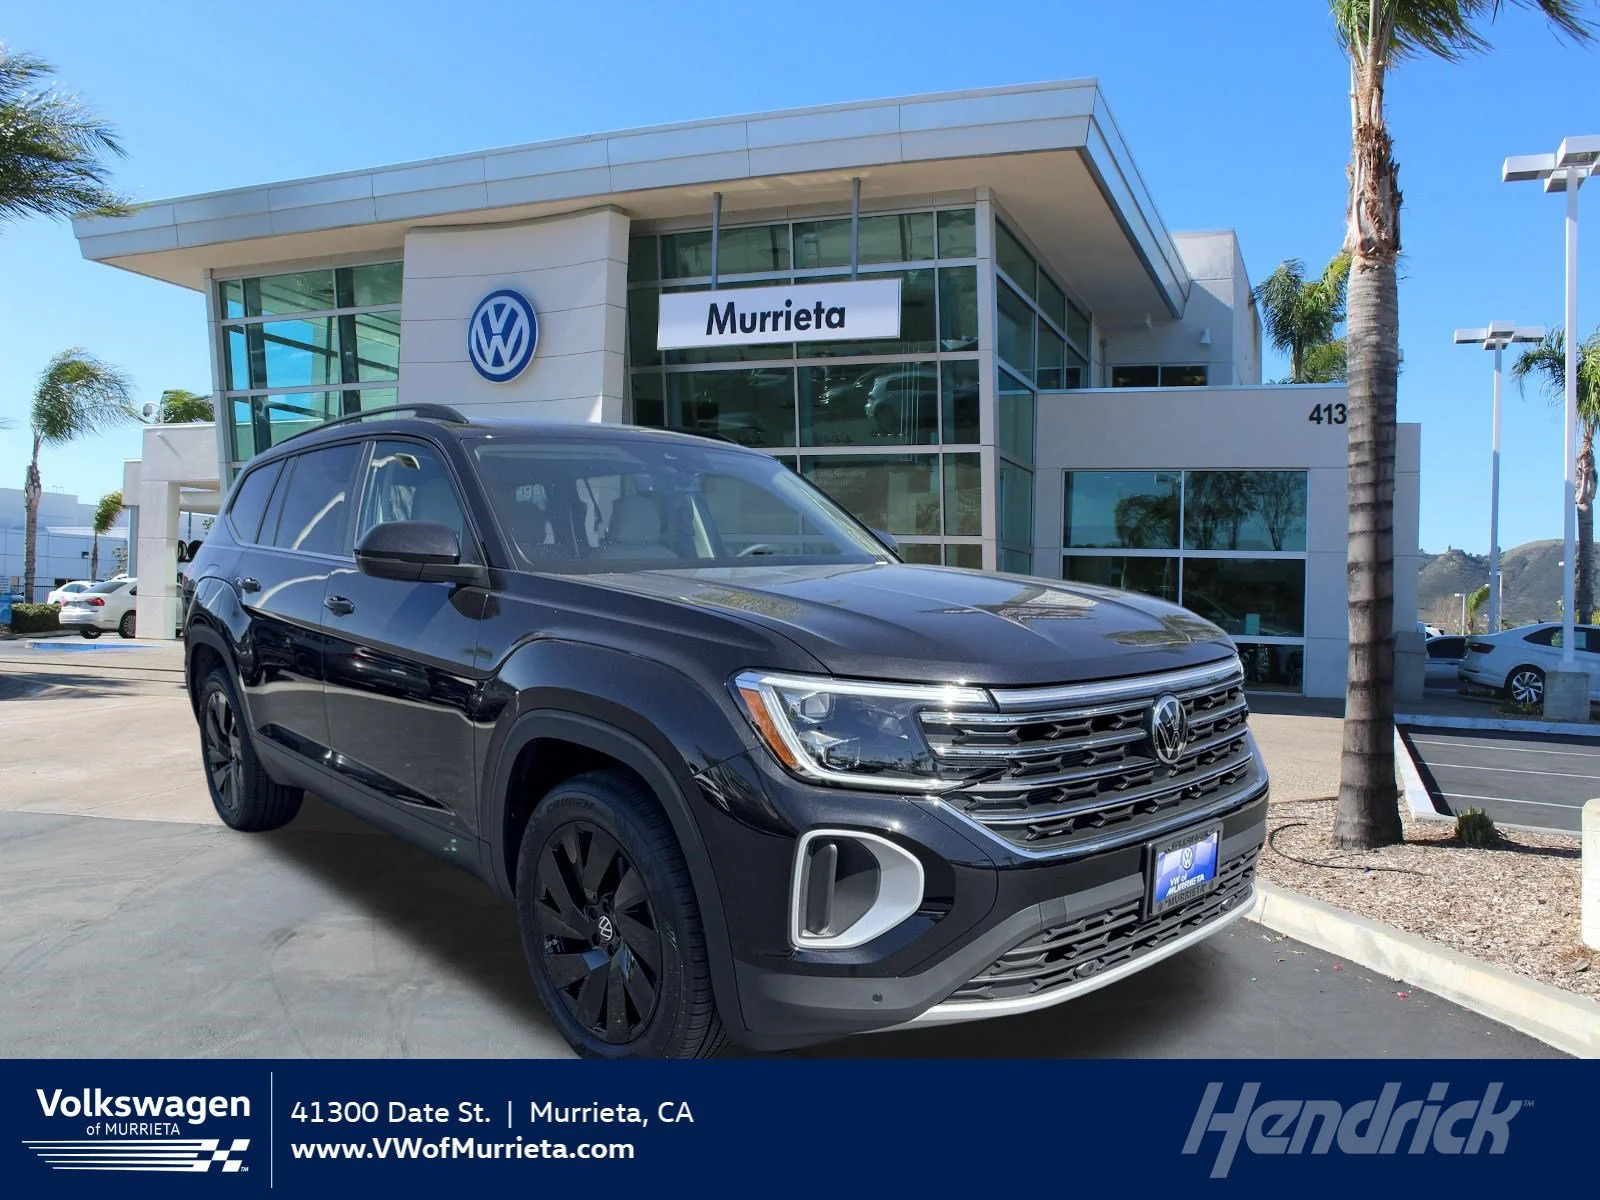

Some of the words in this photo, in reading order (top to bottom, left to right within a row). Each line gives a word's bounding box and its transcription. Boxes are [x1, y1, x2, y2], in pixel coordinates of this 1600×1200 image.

[706, 299, 846, 336] Murrieta
[1308, 403, 1347, 425] 413
[1166, 873, 1205, 897] MURRIETA
